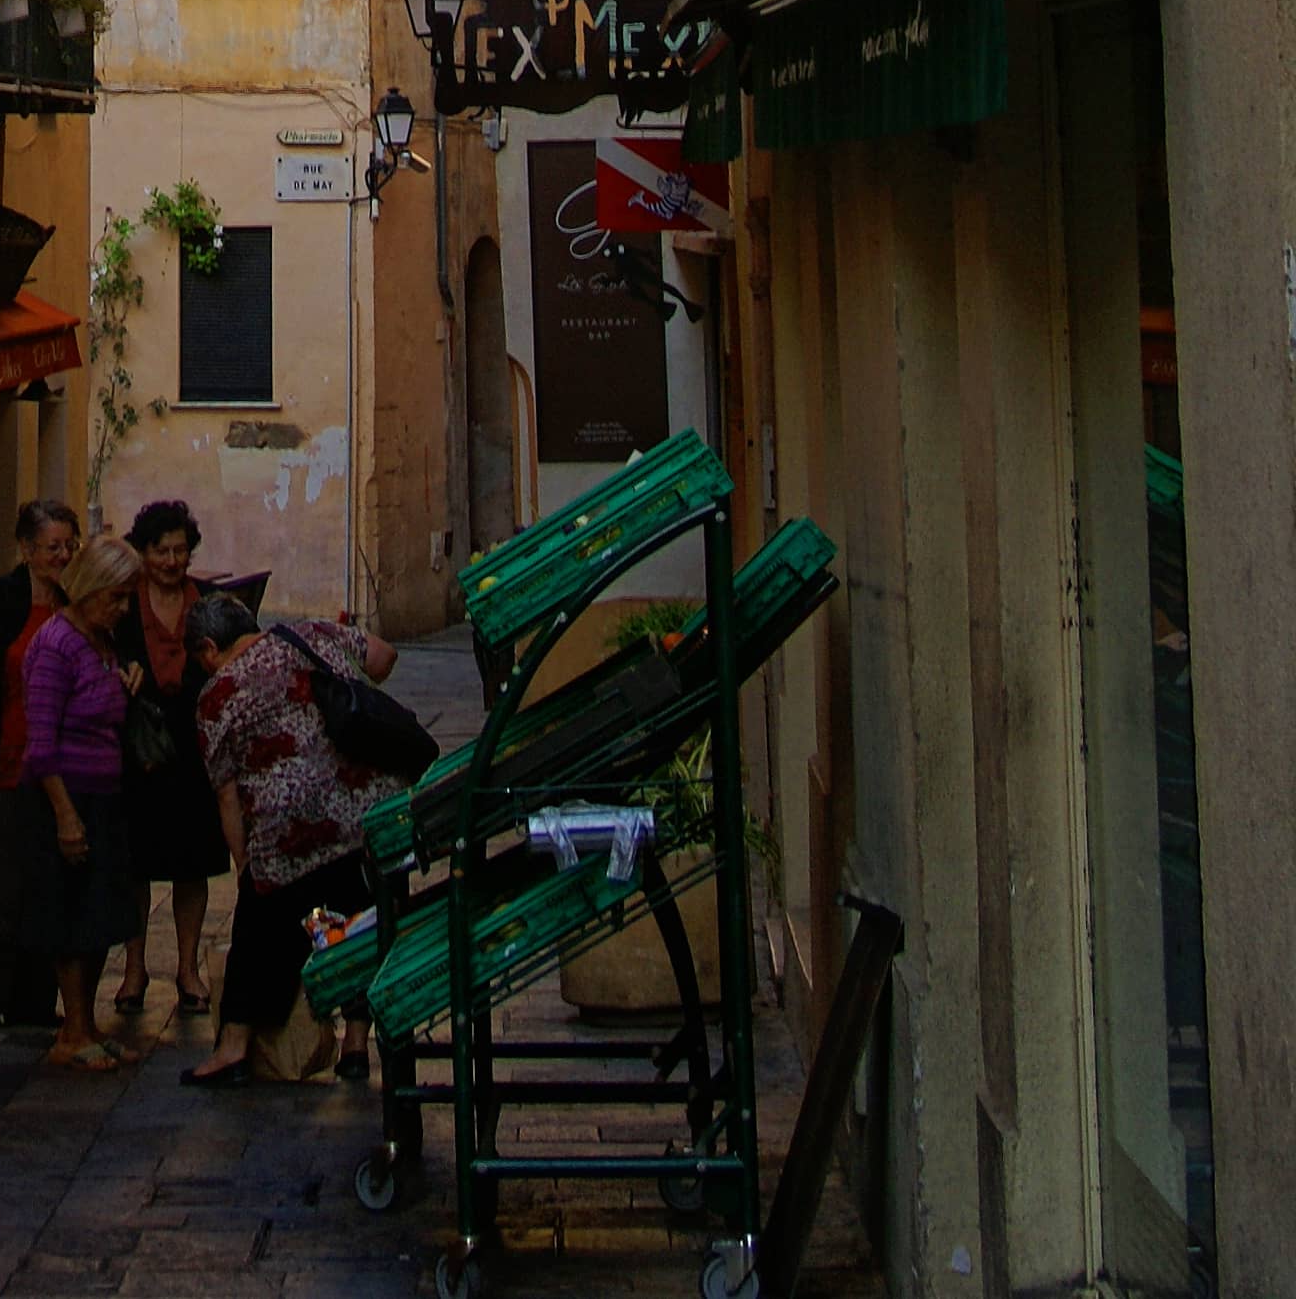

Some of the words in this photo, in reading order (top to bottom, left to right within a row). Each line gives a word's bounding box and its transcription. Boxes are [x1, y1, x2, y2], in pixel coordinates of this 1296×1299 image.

[304, 164, 323, 175] RUE
[294, 181, 306, 191] DE
[313, 180, 333, 191] MAY
